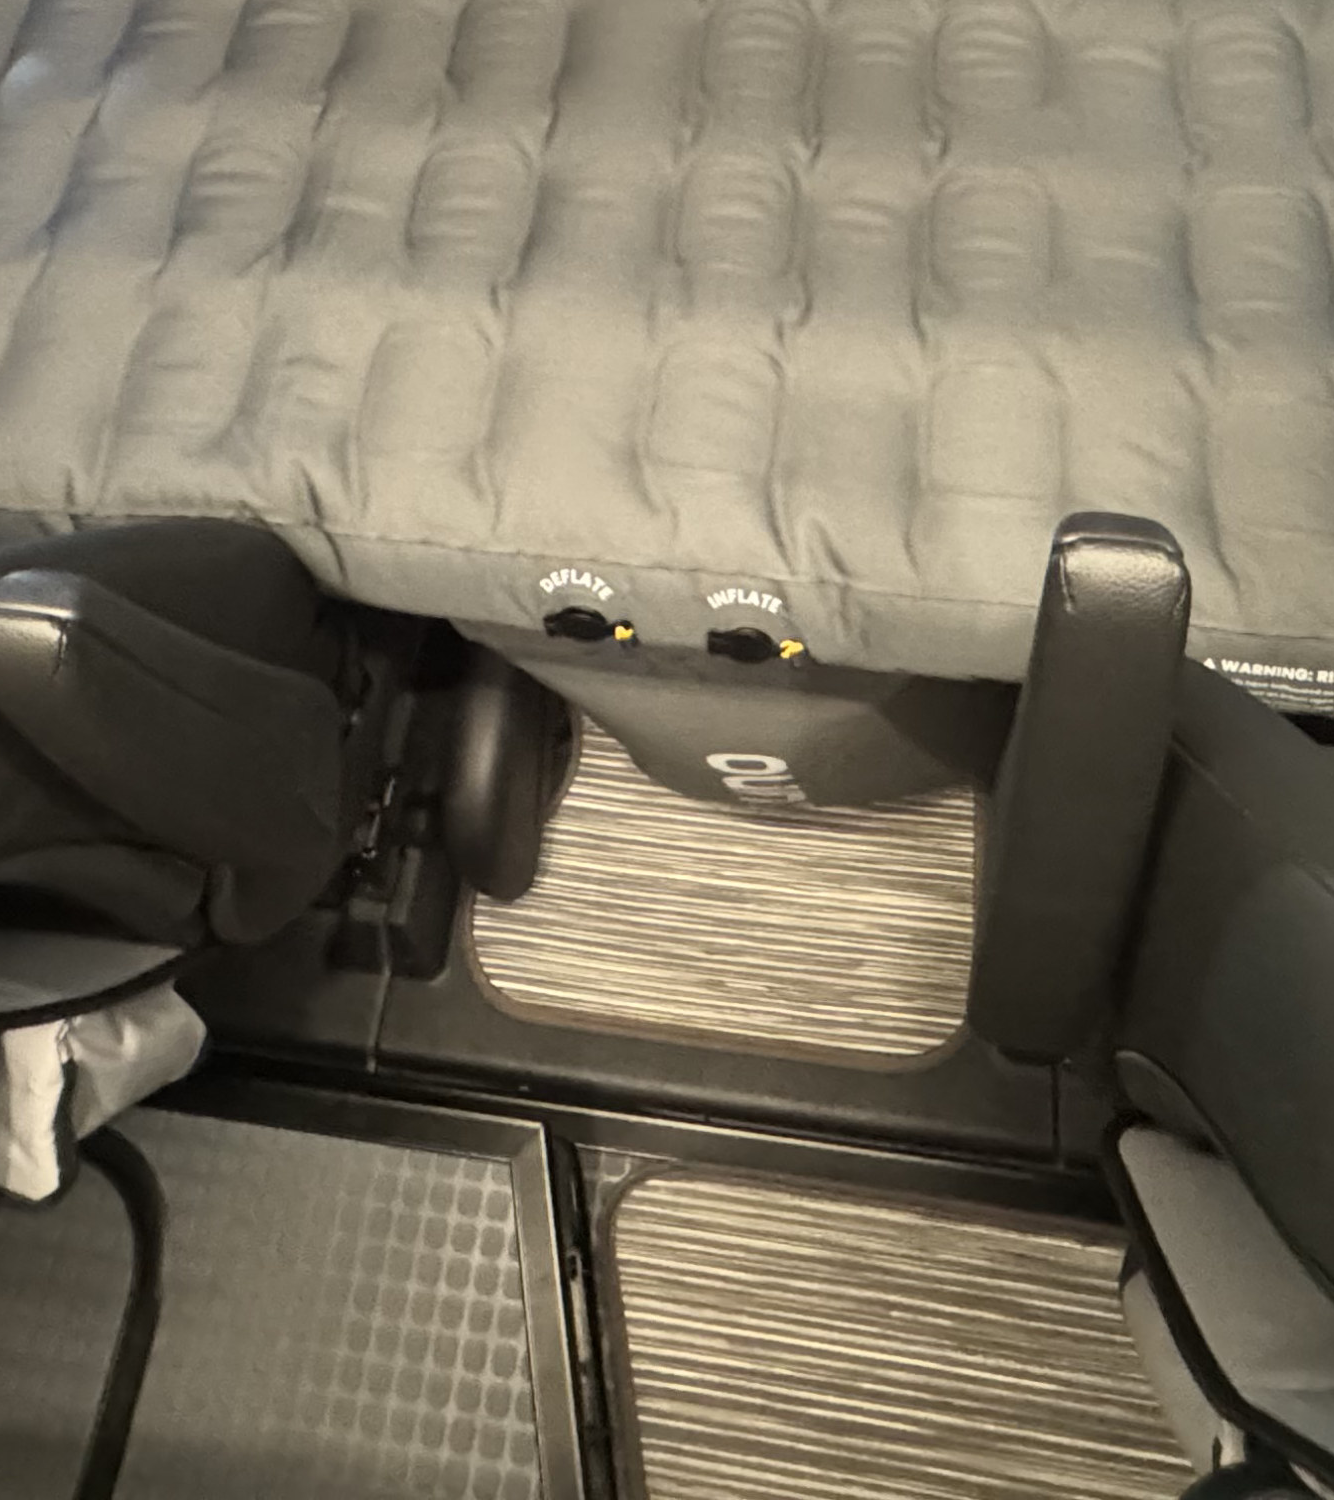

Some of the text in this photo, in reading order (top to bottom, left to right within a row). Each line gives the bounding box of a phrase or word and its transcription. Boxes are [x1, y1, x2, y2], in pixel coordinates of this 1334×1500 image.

[540, 569, 614, 601] DEFLATE
[707, 588, 782, 614] INFLATE
[1221, 658, 1314, 682] WARNING:
